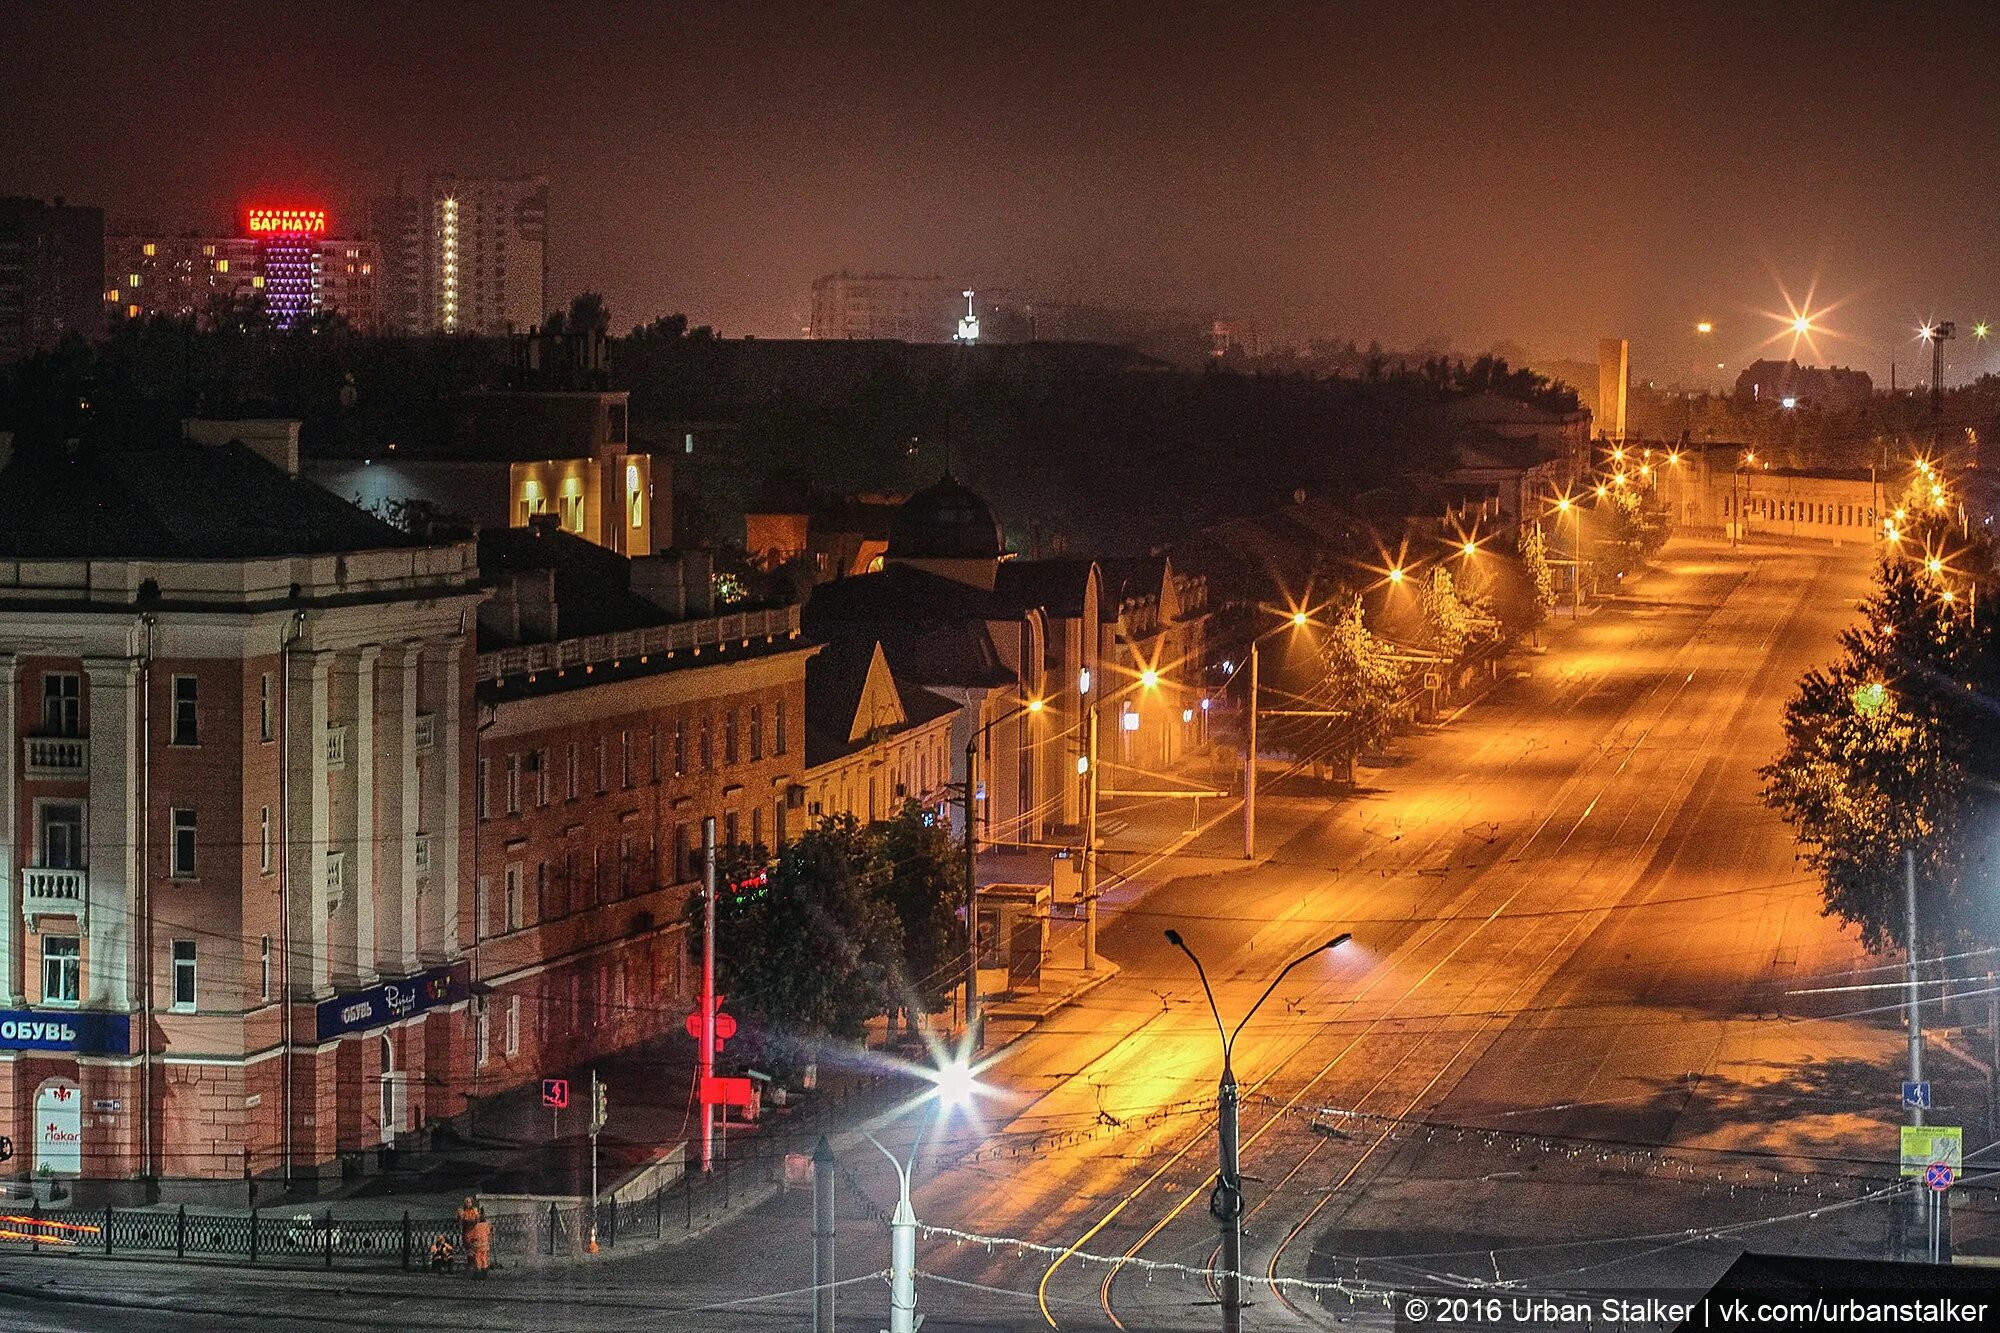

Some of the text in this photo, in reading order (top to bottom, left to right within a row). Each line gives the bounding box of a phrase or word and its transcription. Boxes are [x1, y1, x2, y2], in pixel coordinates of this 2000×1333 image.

[250, 218, 325, 231] БАРНАУЛ
[343, 1001, 373, 1024] ОБУВЬ
[0, 1021, 77, 1041] ОБУВЬ
